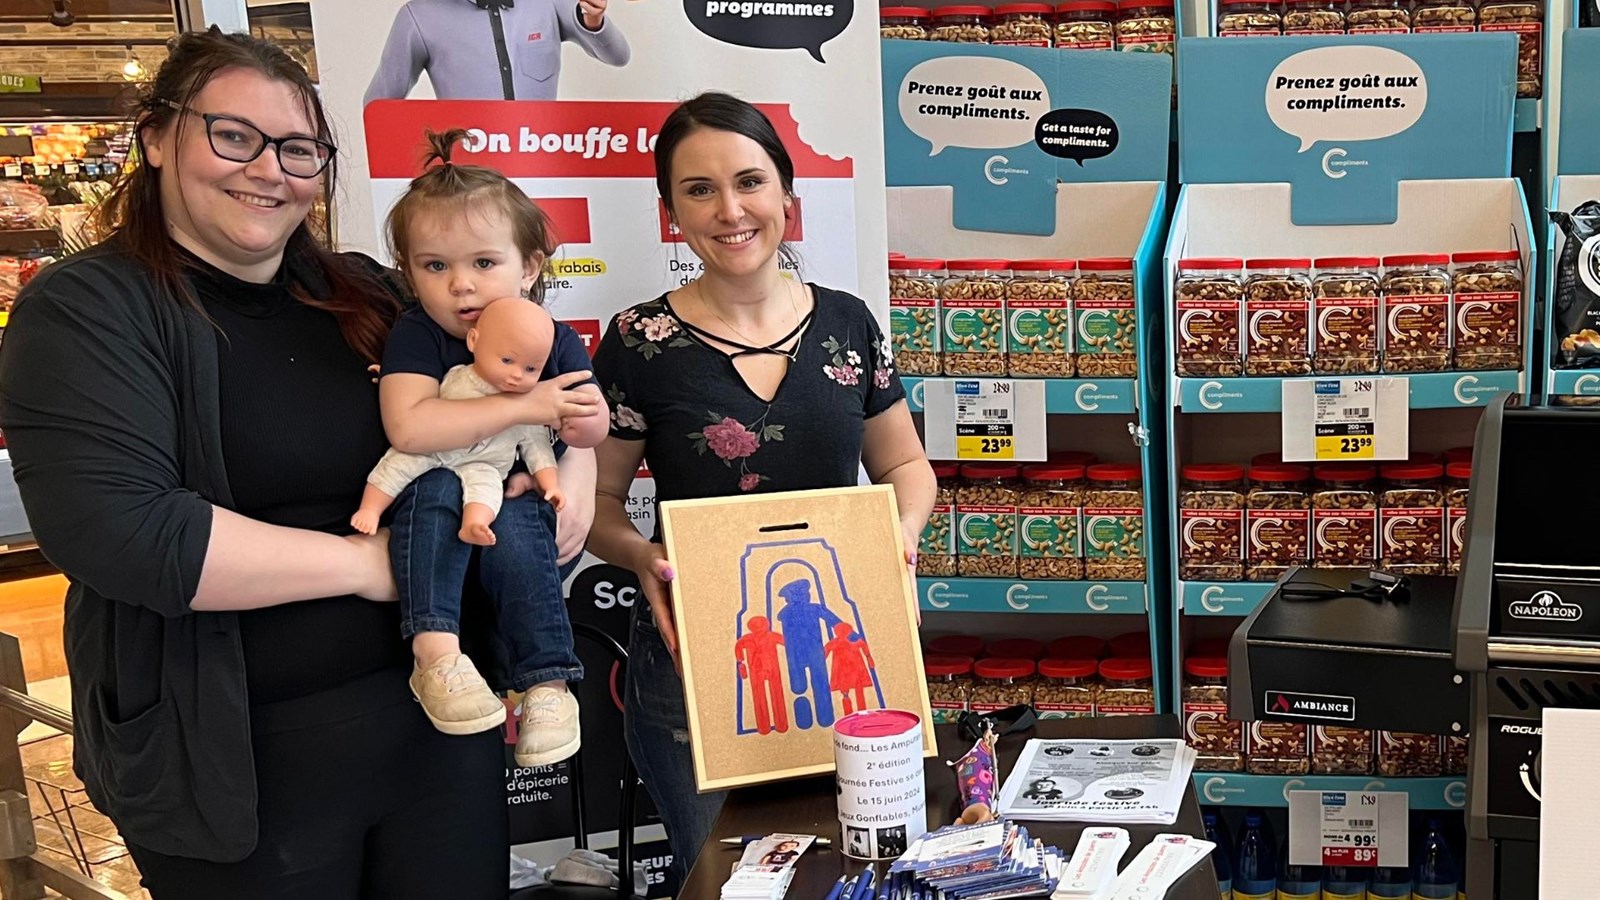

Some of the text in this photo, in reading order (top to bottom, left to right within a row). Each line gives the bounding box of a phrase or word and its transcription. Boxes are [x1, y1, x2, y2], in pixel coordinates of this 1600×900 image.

[706, 1, 834, 18] programmes
[1276, 74, 1418, 92] Prenez goût aux
[908, 81, 1042, 102] Prenez goût aux
[1287, 94, 1406, 112] compliments.
[918, 103, 1030, 120] compliments.
[1042, 123, 1058, 133] Get
[1069, 124, 1094, 134] taste
[1096, 126, 1111, 137] for
[463, 128, 511, 153] On
[519, 127, 628, 159] bouffe
[1042, 135, 1110, 148] compliments.
[559, 261, 602, 273] rabais
[670, 260, 694, 272] Des
[1514, 605, 1576, 618] NAPOLEON
[1294, 700, 1349, 713] AMBIANCE
[871, 744, 888, 752] Les
[879, 757, 911, 769] édition
[507, 775, 569, 791] d'épicerie
[869, 777, 904, 788] Festive
[508, 792, 552, 805] ratuite.
[857, 797, 868, 805] Le
[871, 796, 882, 805] 15
[884, 796, 902, 806] juin
[856, 811, 911, 822] Gonflables,
[1344, 834, 1350, 842] 4
[1324, 848, 1330, 856] 4
